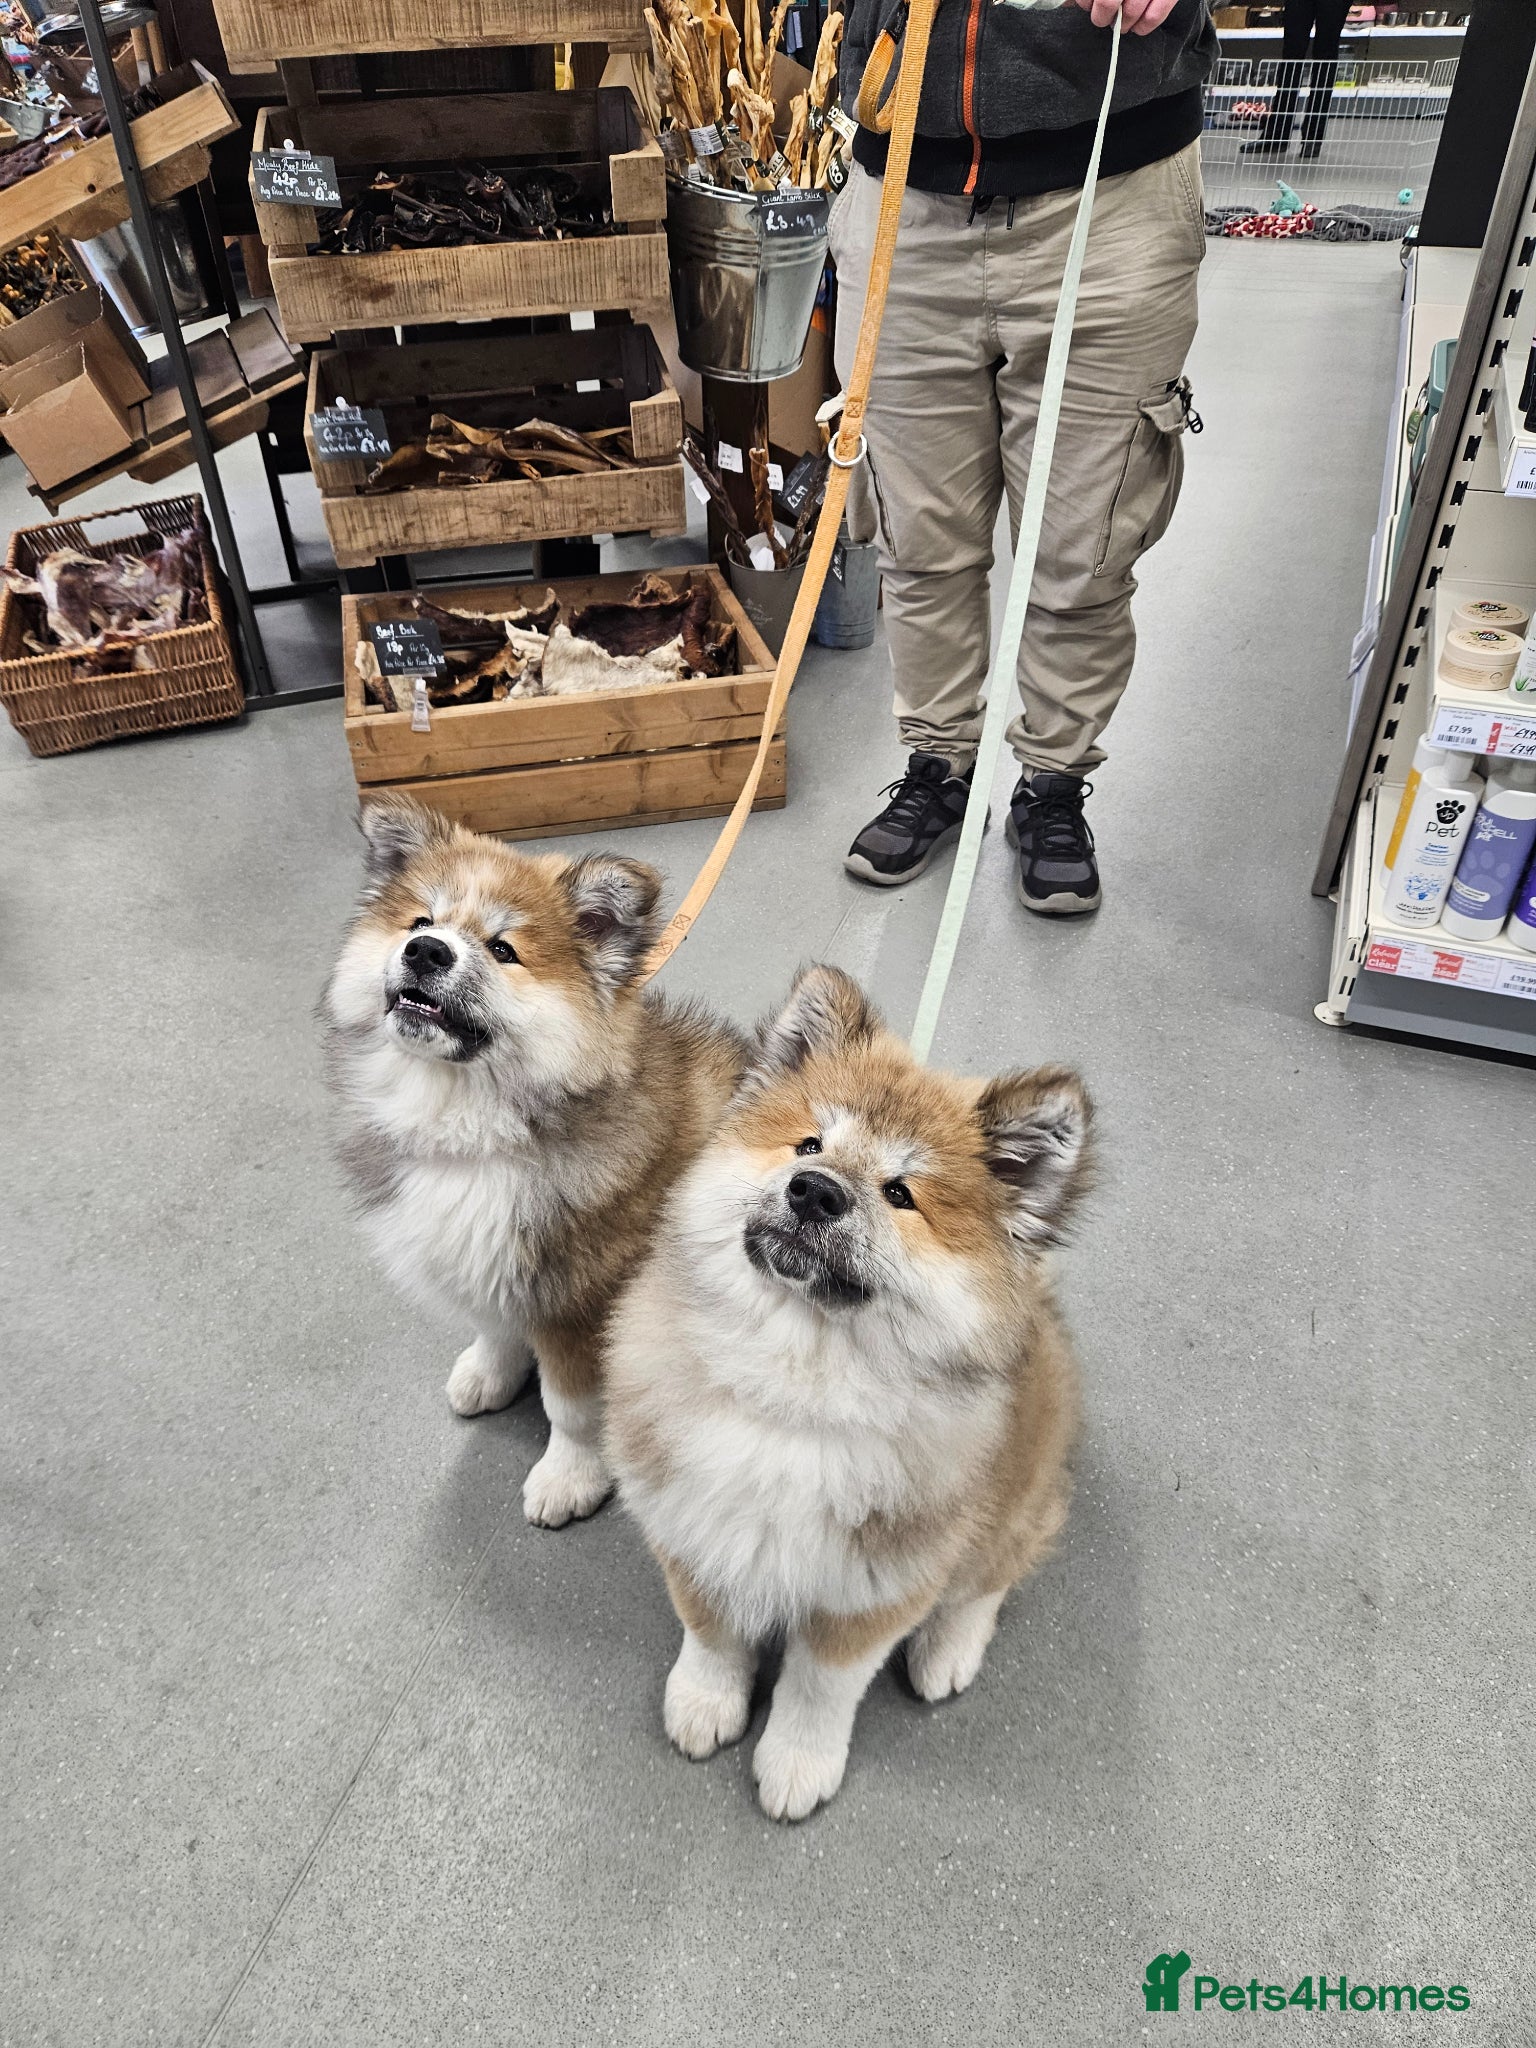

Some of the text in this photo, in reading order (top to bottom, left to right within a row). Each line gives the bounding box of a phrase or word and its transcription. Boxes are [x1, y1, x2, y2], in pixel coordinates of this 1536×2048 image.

[272, 172, 298, 188] 42p
[386, 641, 404, 656] 18p
[1448, 725, 1473, 735] £7.99
